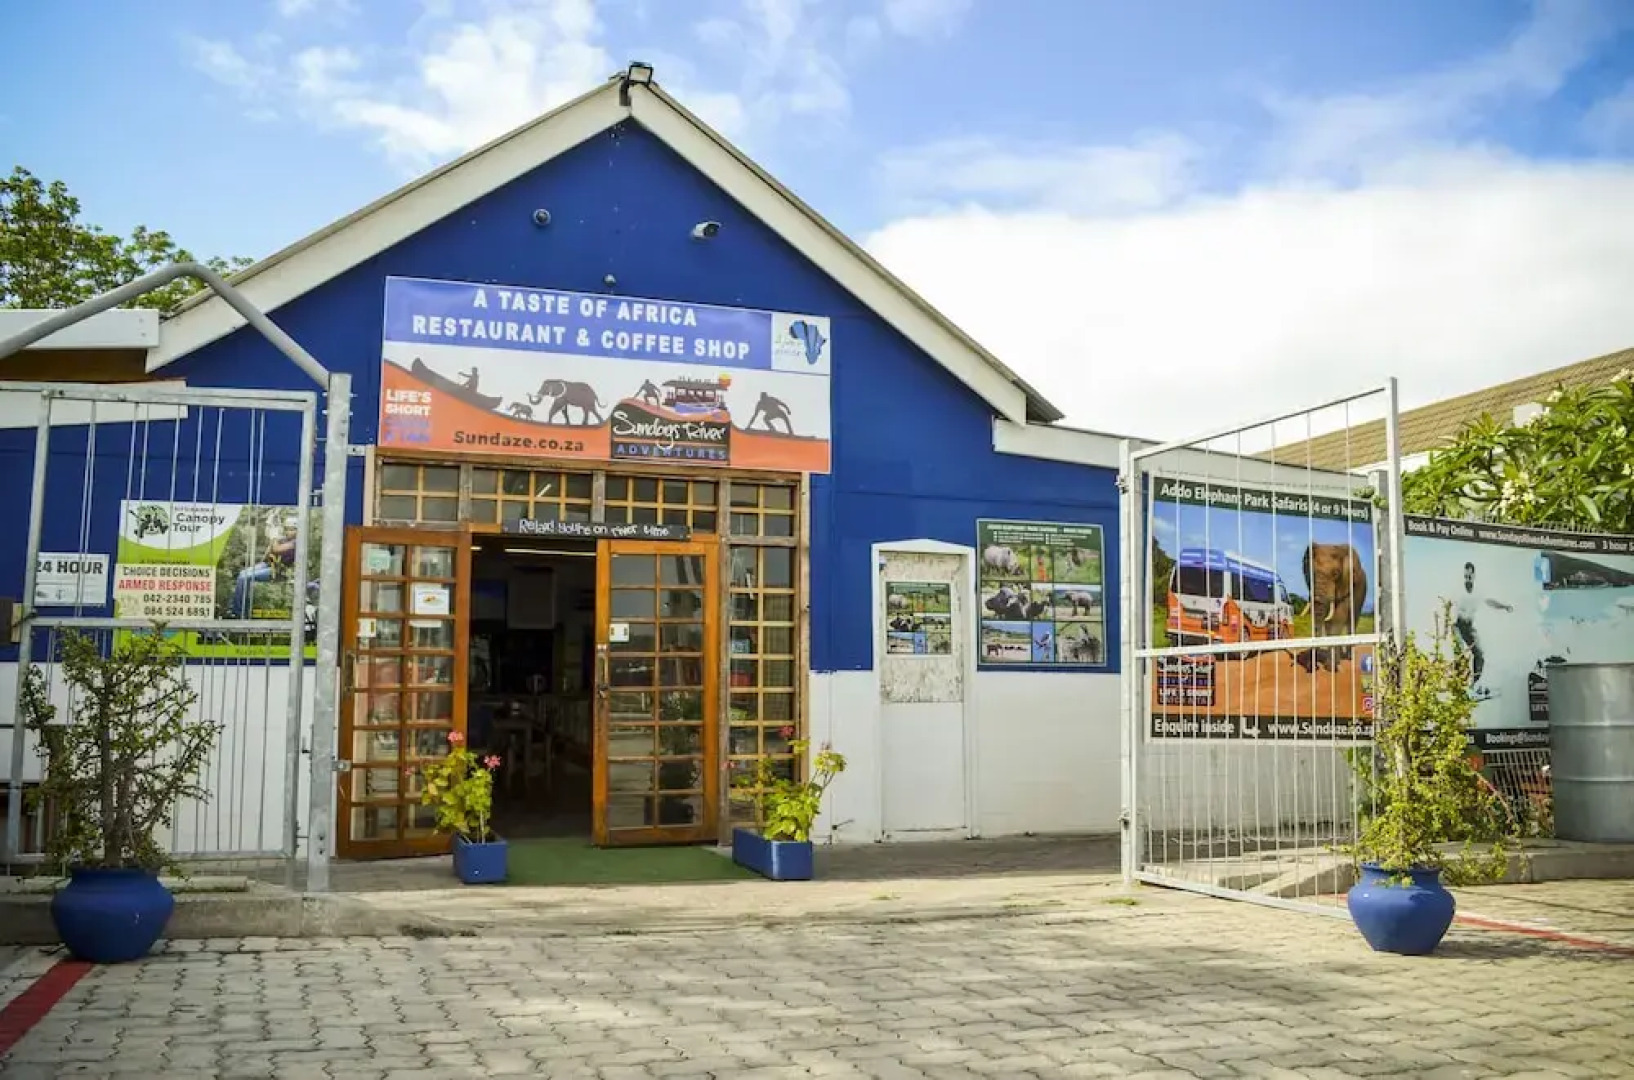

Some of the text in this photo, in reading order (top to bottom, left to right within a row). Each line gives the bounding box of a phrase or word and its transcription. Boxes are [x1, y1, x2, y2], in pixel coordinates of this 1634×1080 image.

[473, 288, 698, 327] A TASTE OF AFRICA
[412, 314, 567, 345] RESTAURANT
[576, 328, 591, 347] &
[601, 329, 684, 354] COFFEE
[694, 338, 751, 360] SHOP
[385, 389, 432, 403] LIFE'S
[384, 403, 432, 416] SHORT
[682, 420, 726, 440] River
[453, 430, 585, 452] Sundaze.co.za
[617, 443, 726, 459] ADVENTURES
[1161, 483, 1192, 499] Addo
[1244, 493, 1269, 508] Park
[1321, 504, 1333, 515] or
[176, 512, 225, 525] Canopy
[173, 523, 201, 532] Tour
[36, 561, 104, 574] 24 HOUR
[118, 579, 212, 592] ARMED RESPONSE
[1155, 719, 1200, 735] Enquire
[1201, 719, 1234, 733] inside
